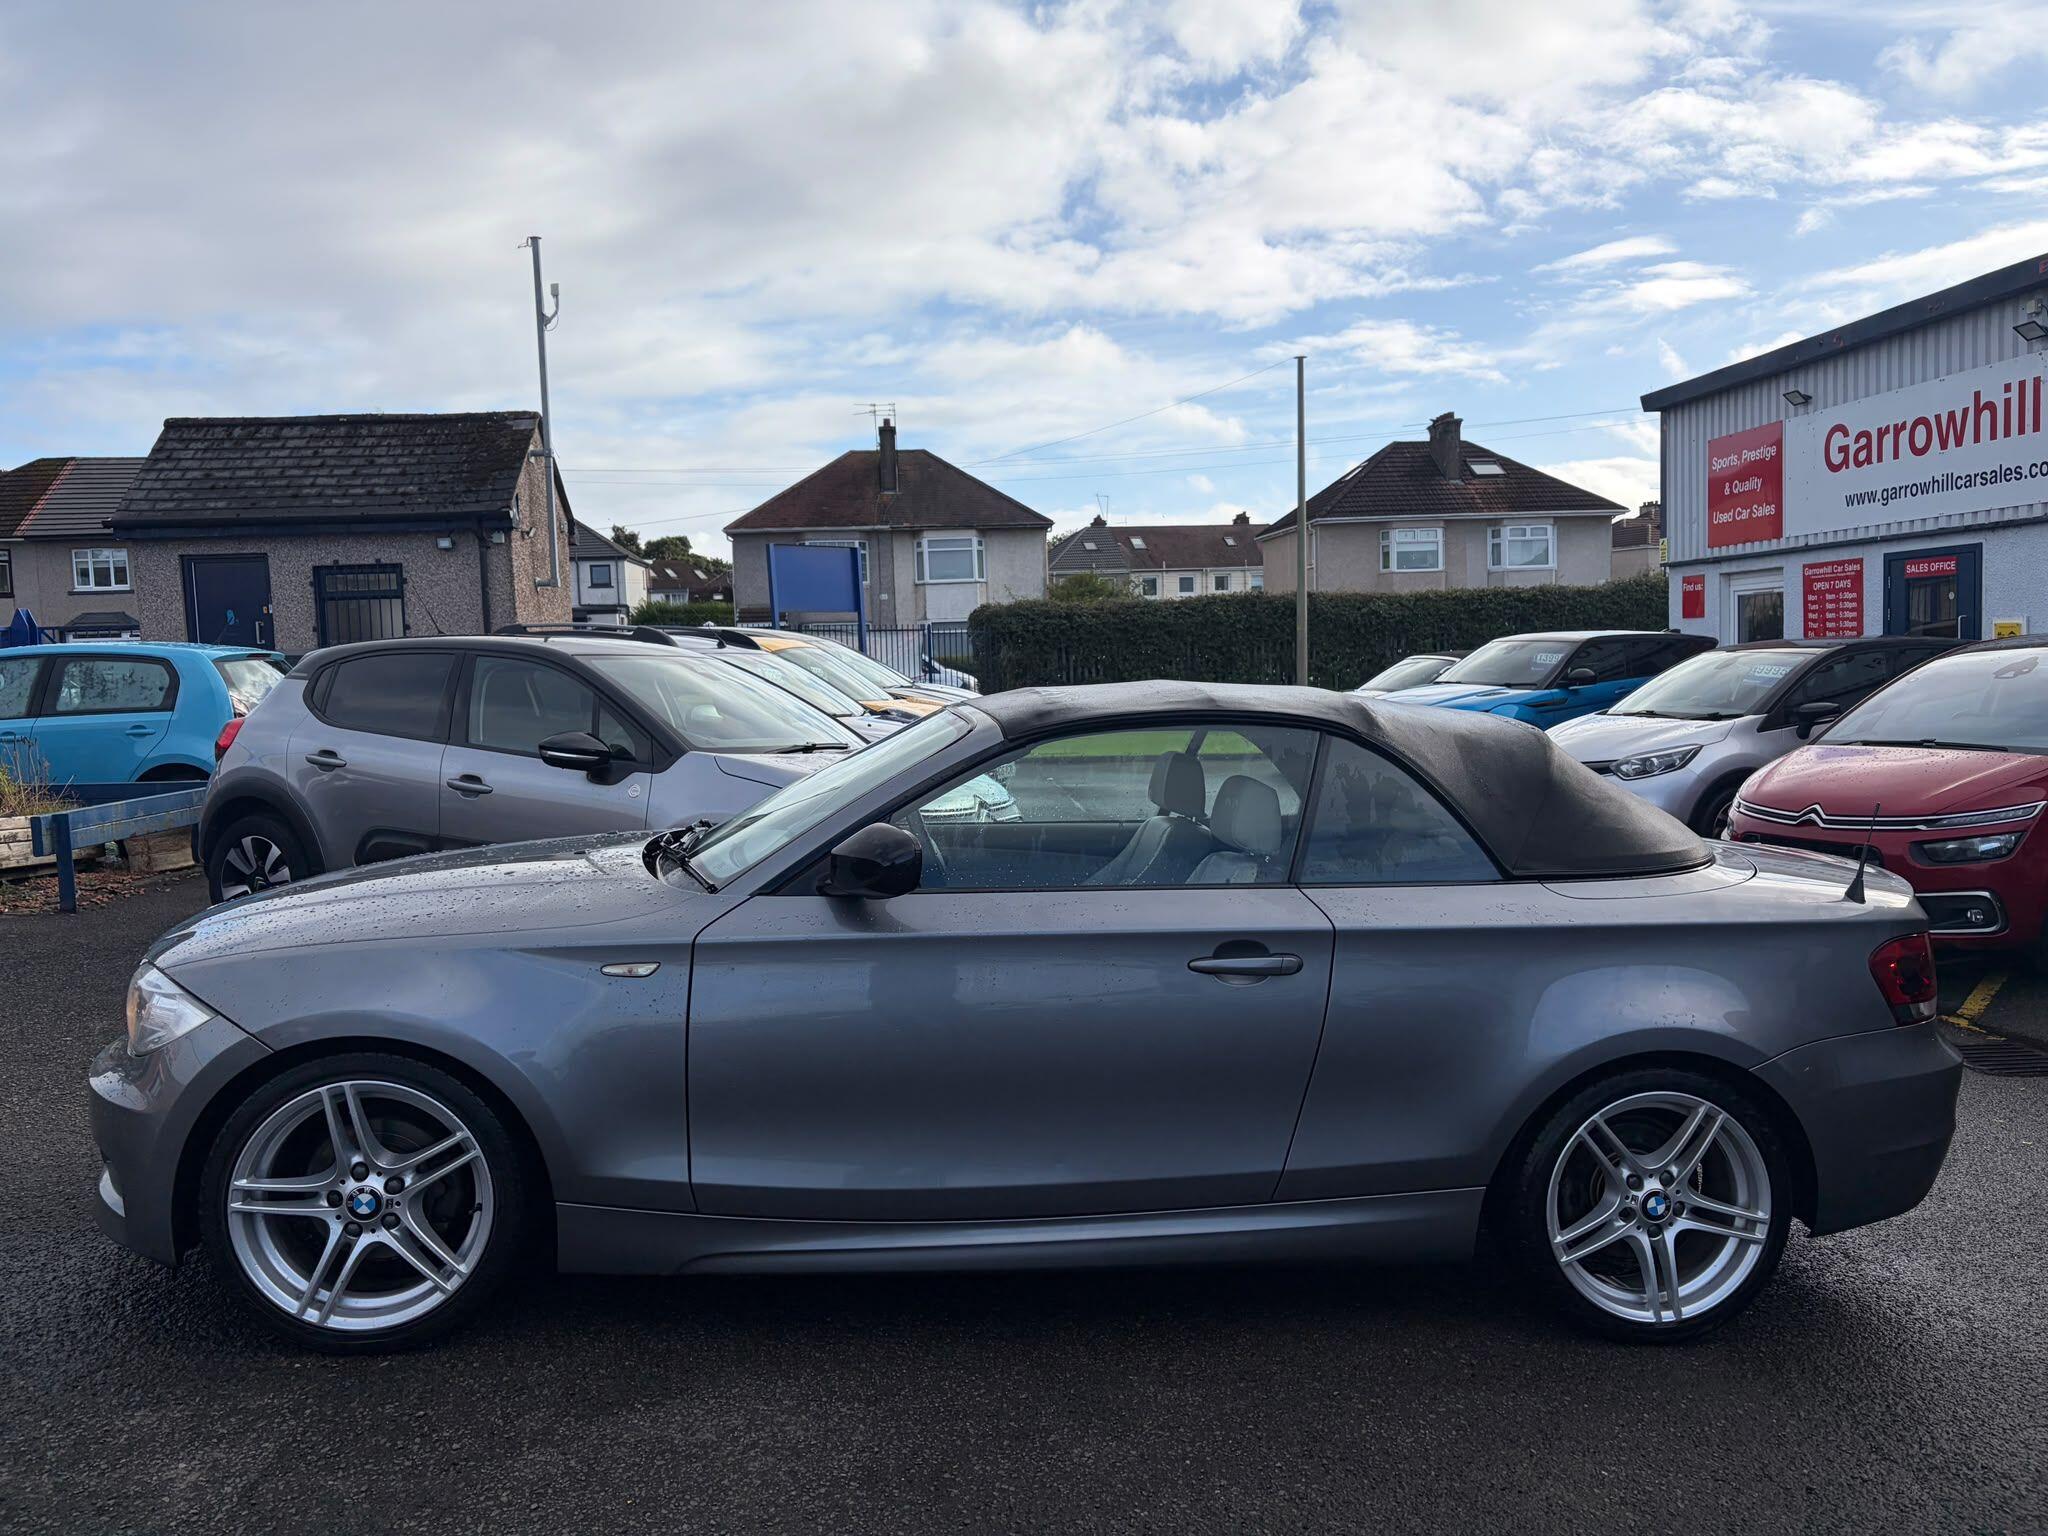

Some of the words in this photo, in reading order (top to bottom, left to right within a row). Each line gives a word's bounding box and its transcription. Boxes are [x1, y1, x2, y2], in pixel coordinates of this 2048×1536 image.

[1824, 375, 2042, 473] Garrowhill
[1712, 453, 1740, 472] Sports,
[1742, 445, 1777, 463] Prestige
[1724, 482, 1731, 495] &
[1732, 476, 1762, 494] Quality
[1845, 460, 2048, 507] www.garrowhillcarsales.co
[1713, 508, 1733, 524] Used
[1735, 506, 1750, 520] Car
[1752, 502, 1776, 518] Sales
[1804, 566, 1832, 575] Garrowhill
[1844, 563, 1860, 571] Sales
[1906, 563, 1929, 574] SALES
[1930, 560, 1956, 571] OFFICE
[1683, 583, 1694, 592] Find
[1813, 581, 1829, 590] OPEN
[1835, 579, 1852, 589] DAYS
